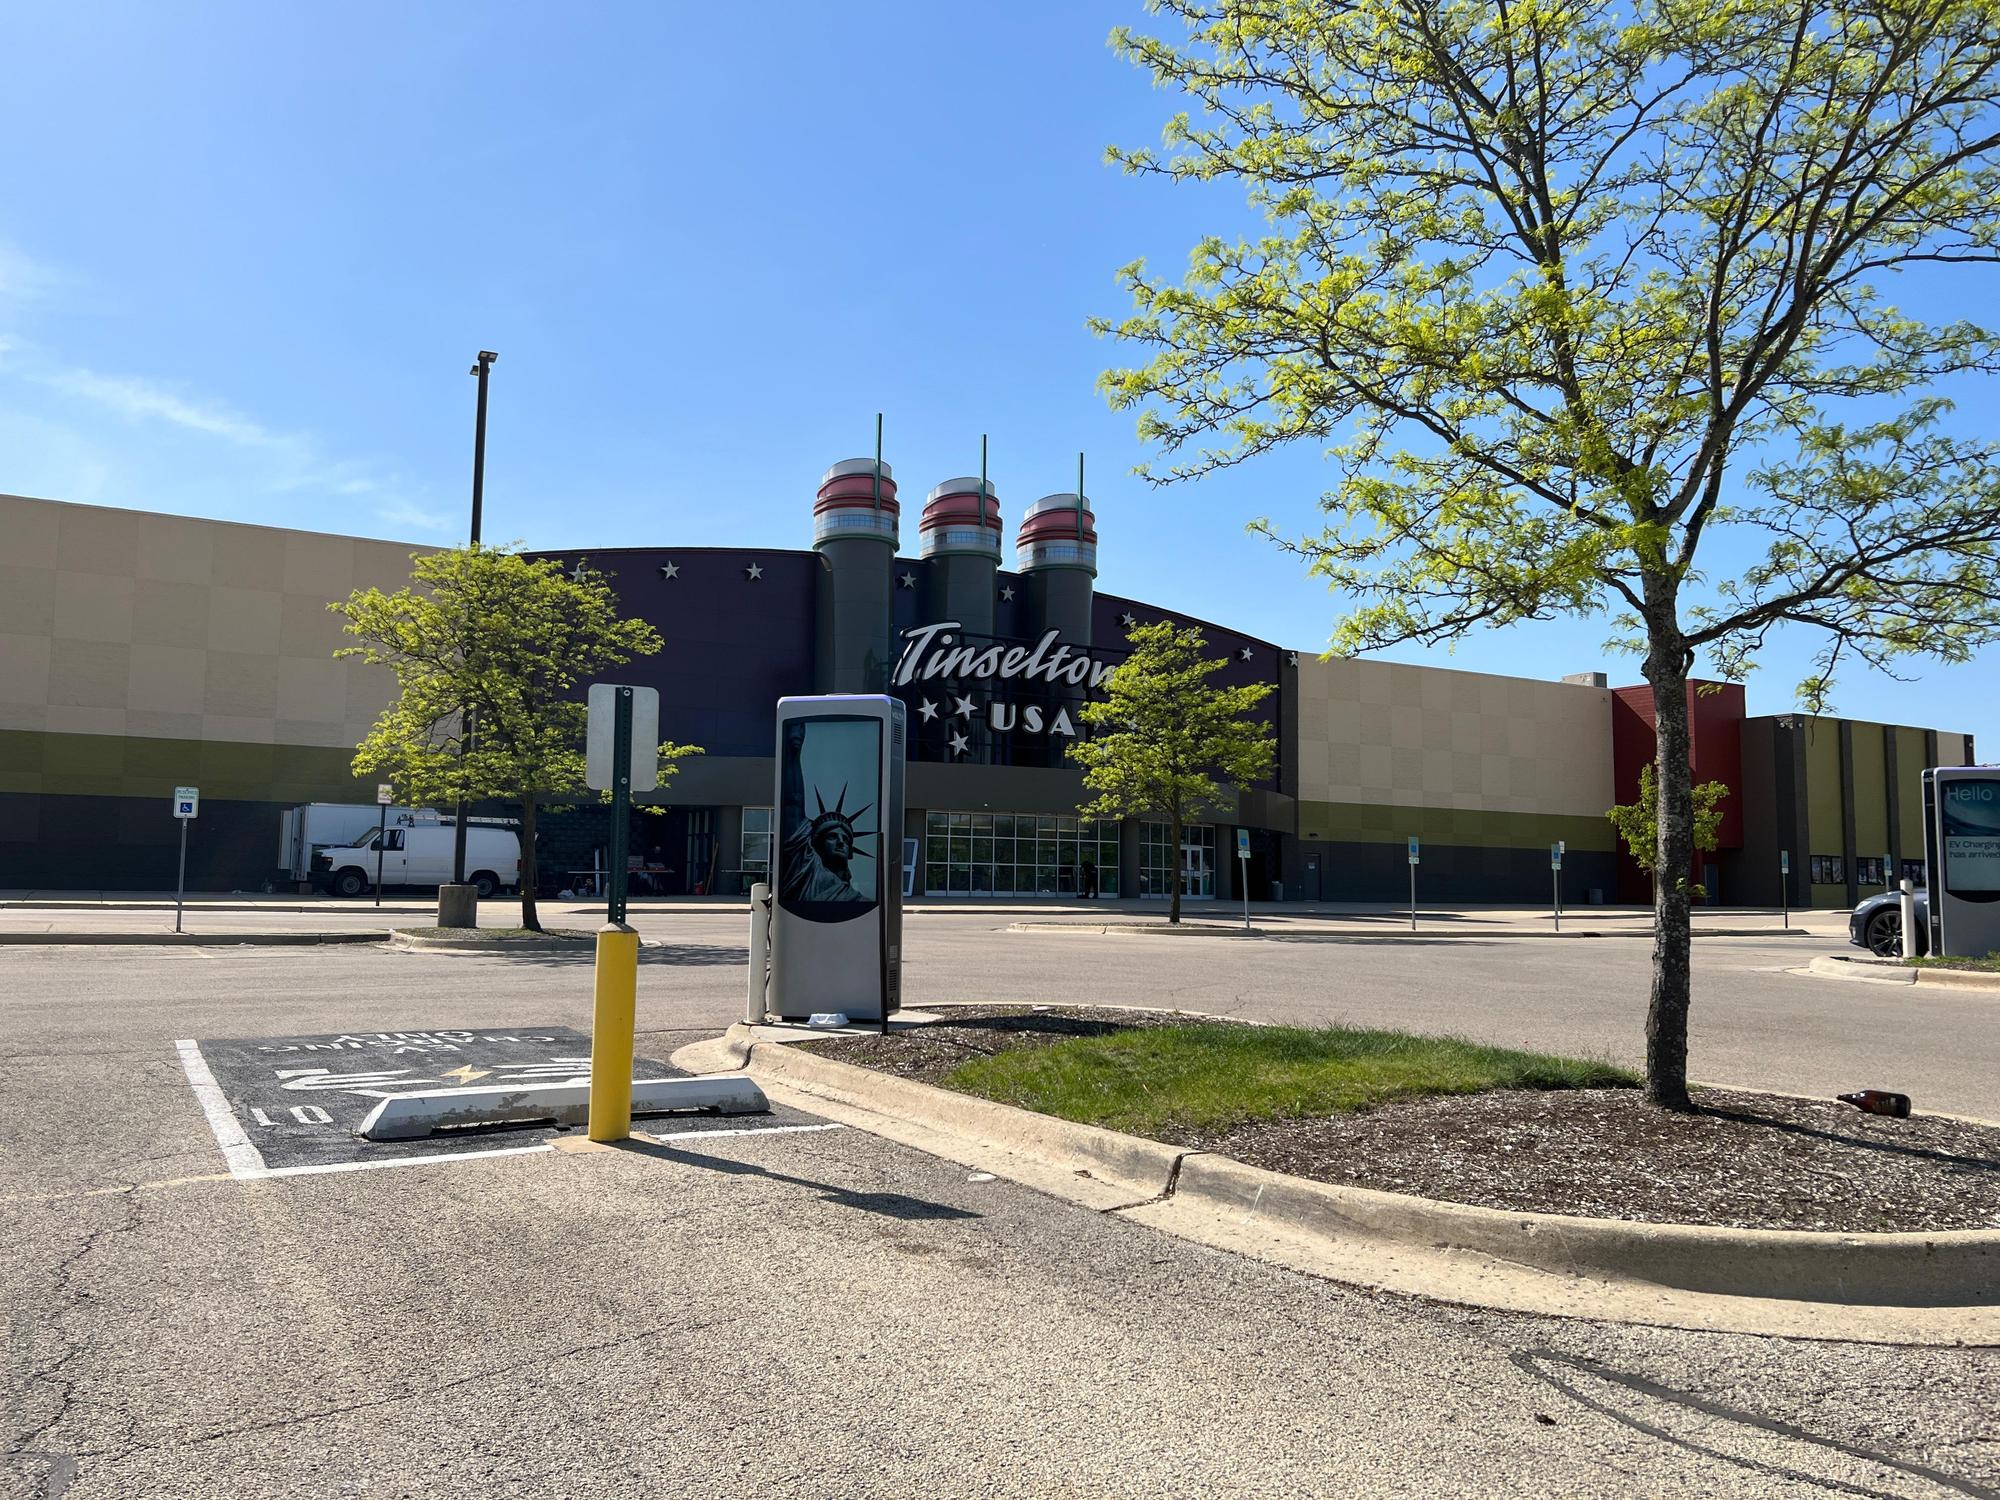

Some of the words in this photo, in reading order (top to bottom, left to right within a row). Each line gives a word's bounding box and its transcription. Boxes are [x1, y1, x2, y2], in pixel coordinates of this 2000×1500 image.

[990, 702, 1076, 736] USA
[1946, 785, 1993, 801] Hello
[1949, 840, 1961, 848] EV
[257, 1036, 556, 1052] CHARGING
[334, 1031, 473, 1043] ONLY
[394, 1045, 462, 1054] EV
